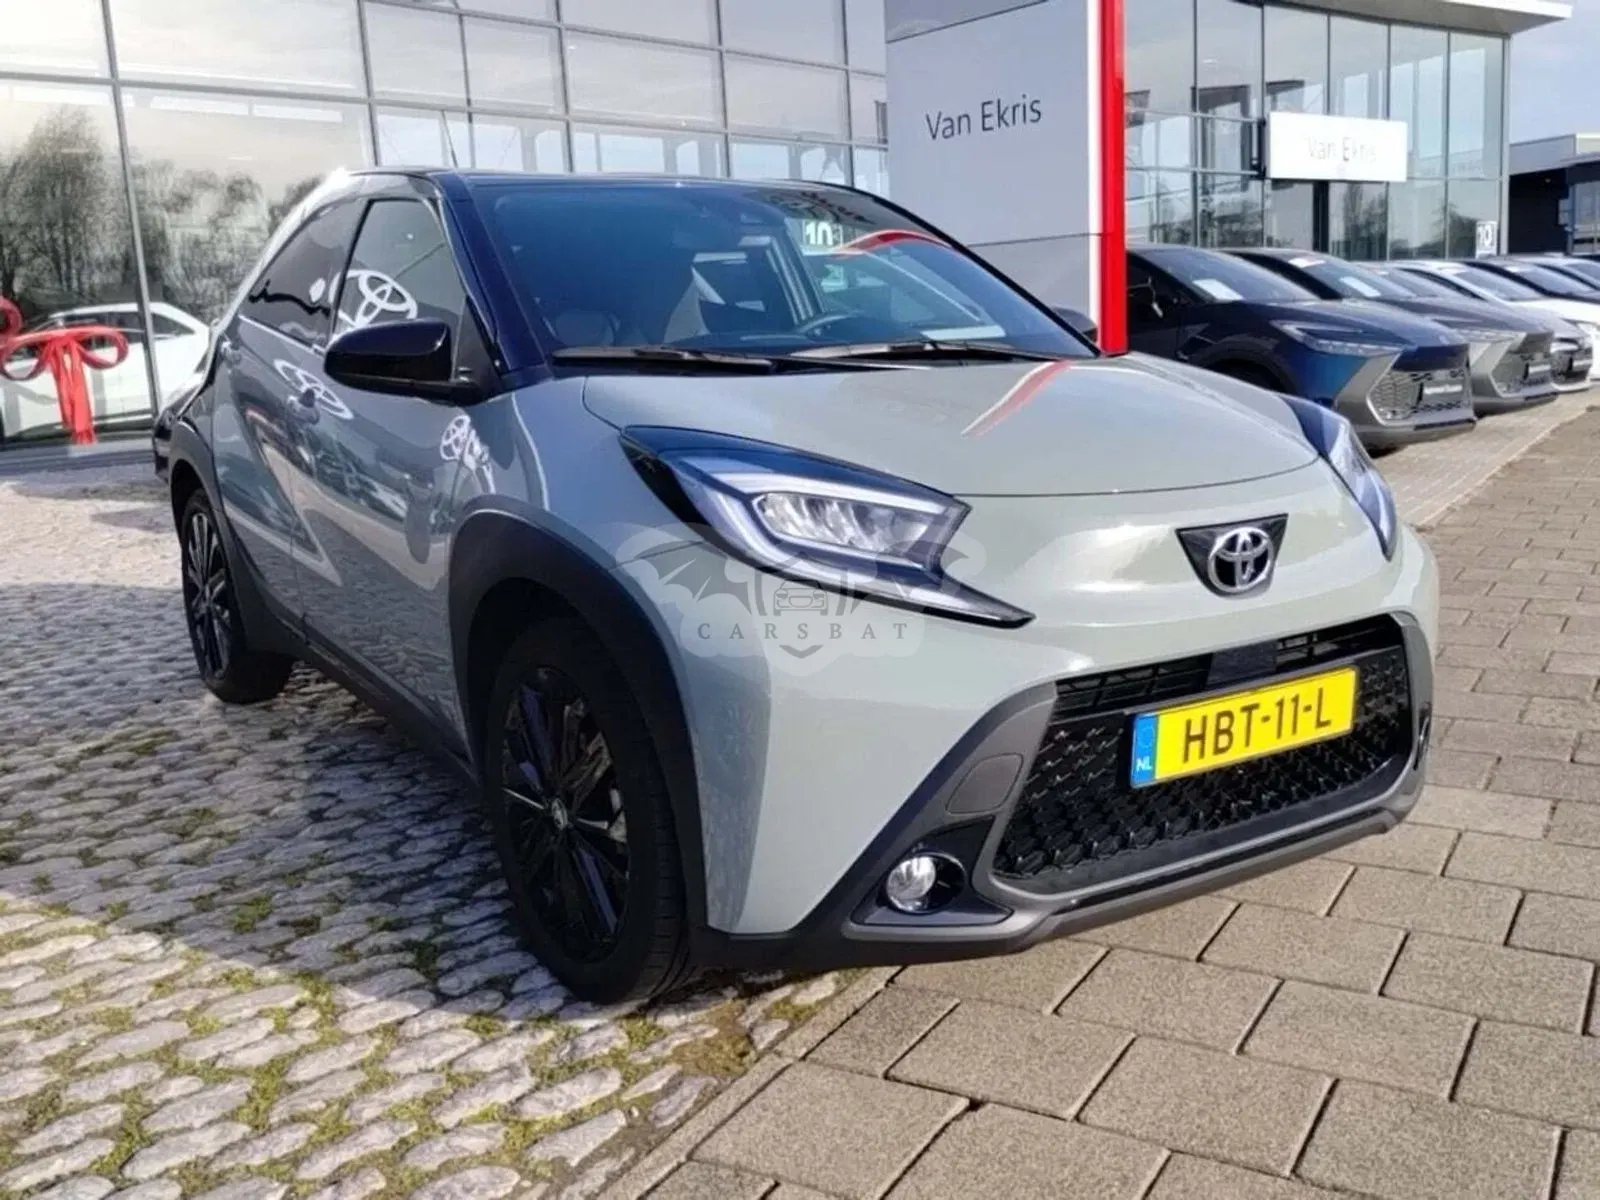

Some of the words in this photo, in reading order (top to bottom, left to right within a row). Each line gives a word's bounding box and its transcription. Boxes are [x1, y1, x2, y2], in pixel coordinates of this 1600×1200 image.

[926, 111, 971, 140] Van
[981, 94, 1042, 132] Ekris
[1183, 687, 1331, 764] HBT-11-L
[1136, 756, 1152, 772] NL
